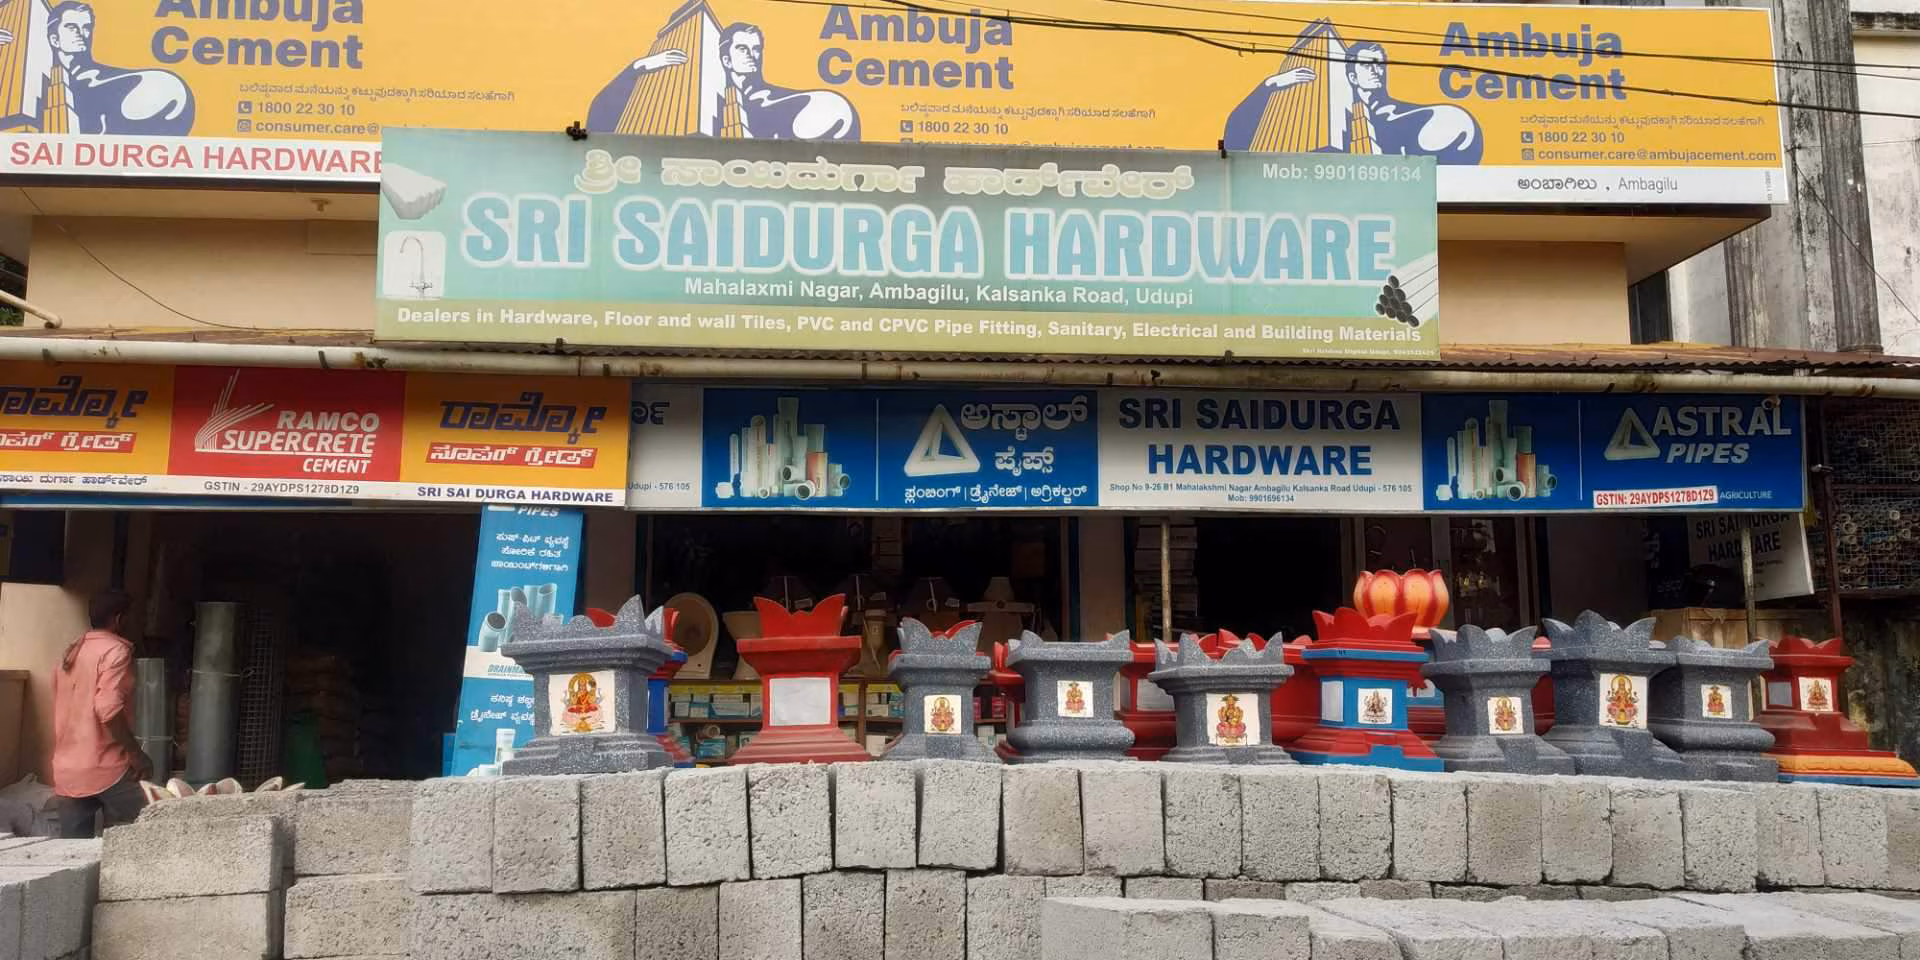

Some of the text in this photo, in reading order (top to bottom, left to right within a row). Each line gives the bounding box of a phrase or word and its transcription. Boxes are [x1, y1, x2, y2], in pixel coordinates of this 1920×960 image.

[819, 4, 1013, 53] Ambuja
[151, 26, 363, 69] Cement
[1440, 22, 1624, 67] Ambuja
[817, 48, 1014, 90] Cement
[1439, 68, 1627, 101] Cement
[257, 101, 355, 116] 1800 22 30 10
[255, 120, 380, 135] consumer.care@
[919, 121, 1009, 135] 1800 22 30 10
[1538, 131, 1625, 143] 1800 22 30 10
[10, 142, 64, 166] SAI
[75, 143, 194, 169] DURGA
[1538, 149, 1777, 164] consumer.care@ambujacement.com
[574, 149, 641, 194] ಶ್ರೀ
[1263, 163, 1422, 182] Mob: 9901696134
[1518, 175, 1597, 190] ಅಂಬಾಗಿಲು
[1618, 177, 1678, 193] Ambagilu
[461, 193, 1396, 286] SRI SAIDURGA HARDWARE
[685, 277, 1193, 306] Mahalaxmi Nagar, Ambagilu, Kalsanka Road, Udupi
[398, 308, 1421, 345] Dealers in Hardware, Floor and wall Tiles, PVC and CPVC Pipe Fitting, Sanitary, Electrical and Building Materials
[277, 410, 380, 432] RAMCO
[1119, 399, 1400, 431] SRI SAIDURGA
[1652, 406, 1791, 436] ASTRAL
[222, 430, 376, 454] SUPERCRETE
[1148, 444, 1371, 476] HARDWARE
[1666, 443, 1750, 464] PIPES
[303, 458, 371, 474] CEMENT
[204, 481, 240, 492] GSTIN
[251, 482, 360, 495] 29AYDPS1278D1Z9
[417, 486, 614, 502] SRI SAI DURGA HARDWARE
[659, 483, 674, 492] 576
[676, 483, 691, 492] 105
[1110, 484, 1130, 493] Shop
[1176, 484, 1226, 492] Mahalakshmi
[1229, 484, 1251, 493] Nagar
[1253, 484, 1291, 494] Ambagilu
[1352, 485, 1376, 494] Udupi
[1596, 489, 1714, 506] GSTIN: 29AYDPS1278D1Z9
[1719, 490, 1772, 499] AGRICULTURE
[1228, 494, 1295, 503] Mob: 9901696134
[517, 505, 560, 517] PIPES
[1696, 518, 1715, 539] SRI
[1709, 531, 1781, 562] HARDARE
[488, 664, 525, 674] DRAINMA
